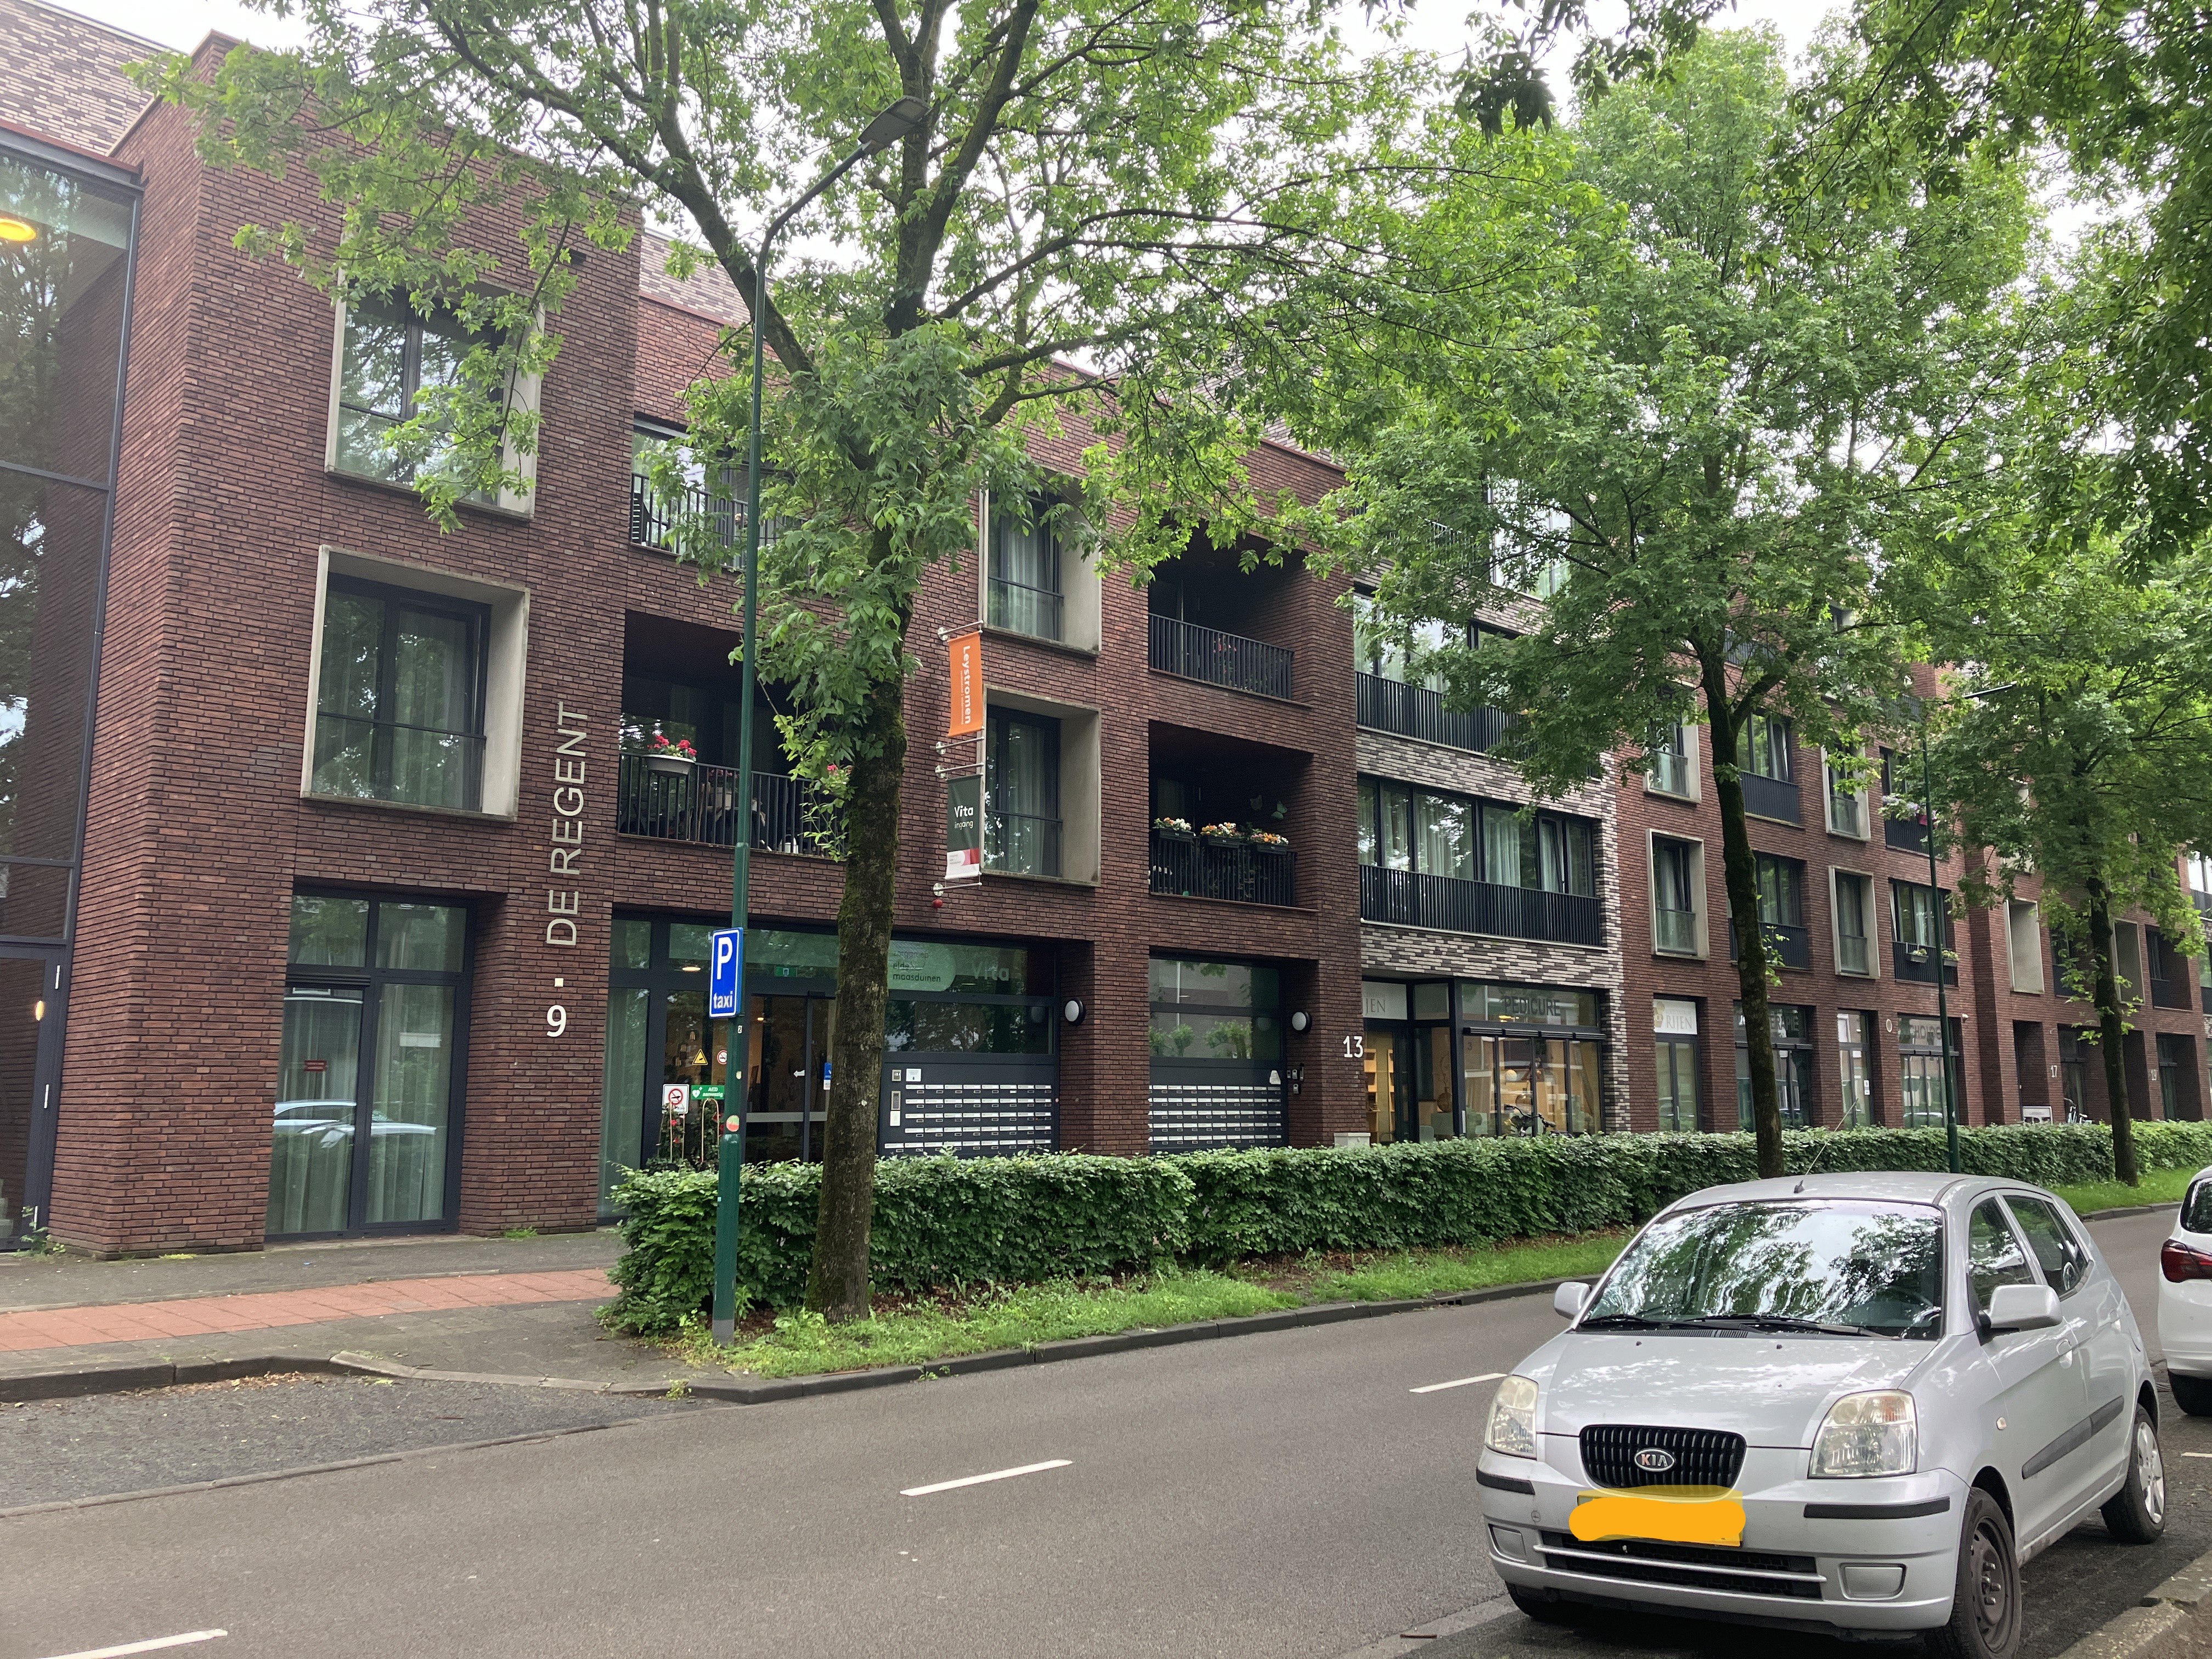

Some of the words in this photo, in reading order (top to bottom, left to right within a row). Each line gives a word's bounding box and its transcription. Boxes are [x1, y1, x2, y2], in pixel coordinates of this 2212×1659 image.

[962, 645, 971, 724] Leystromen
[550, 701, 588, 875] REGENT
[954, 805, 974, 818] Vita
[954, 821, 973, 830] ingang
[546, 890, 579, 945] DE
[716, 936, 733, 980] P
[893, 972, 941, 982] maasduinen
[972, 960, 1009, 981] Vita
[713, 990, 733, 1009] taxi
[1365, 998, 1386, 1016] JEN
[1504, 995, 1561, 1016] PEDICURE
[546, 1005, 567, 1037] 9
[1666, 1015, 1692, 1031] RIJEN
[1342, 1035, 1364, 1058] 13
[2050, 1065, 2057, 1078] 17
[1641, 1454, 1668, 1467] KIA
